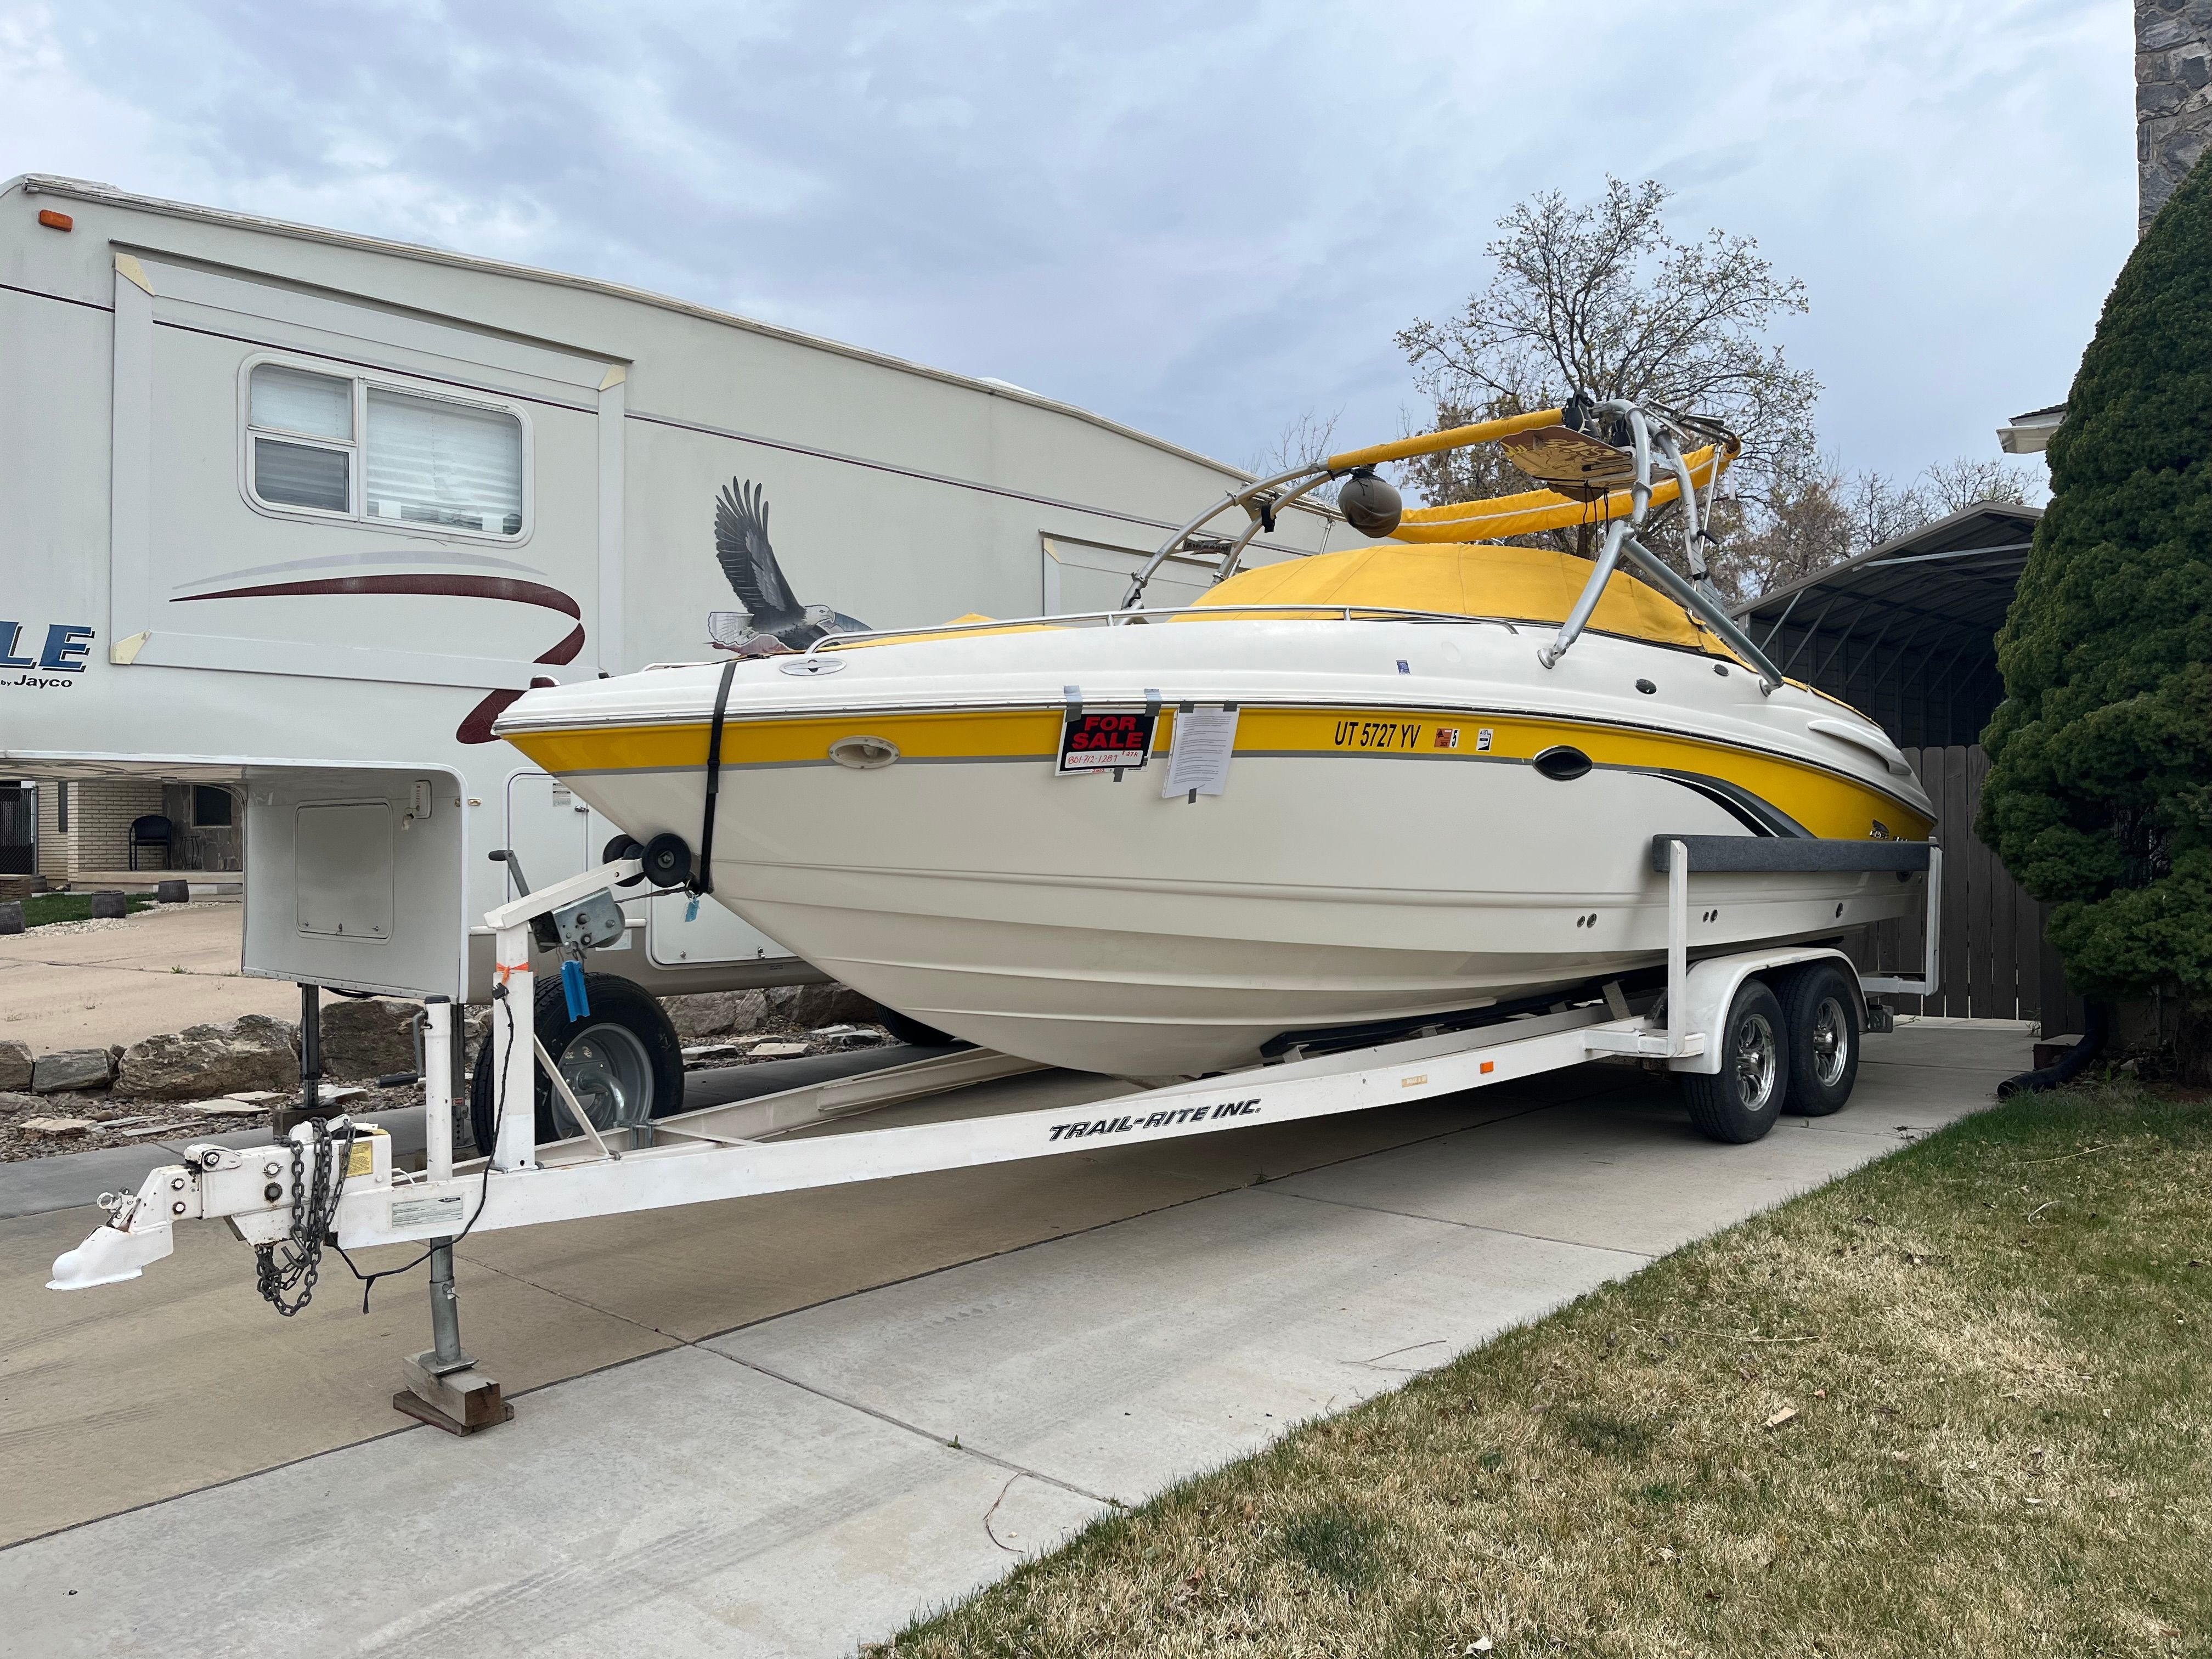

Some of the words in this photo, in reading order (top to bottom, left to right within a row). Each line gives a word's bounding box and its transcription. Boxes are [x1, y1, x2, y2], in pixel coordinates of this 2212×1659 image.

[14, 675, 72, 689] Jayco
[1084, 716, 1136, 731] FOR
[1071, 732, 1144, 749] SALE
[1335, 721, 1359, 746] UT
[1360, 723, 1397, 747] 5727
[1400, 724, 1421, 748] YV
[1452, 730, 1458, 747] 5
[1049, 1105, 1210, 1141] TRAIL-RITE
[1211, 1098, 1262, 1119] INC.
